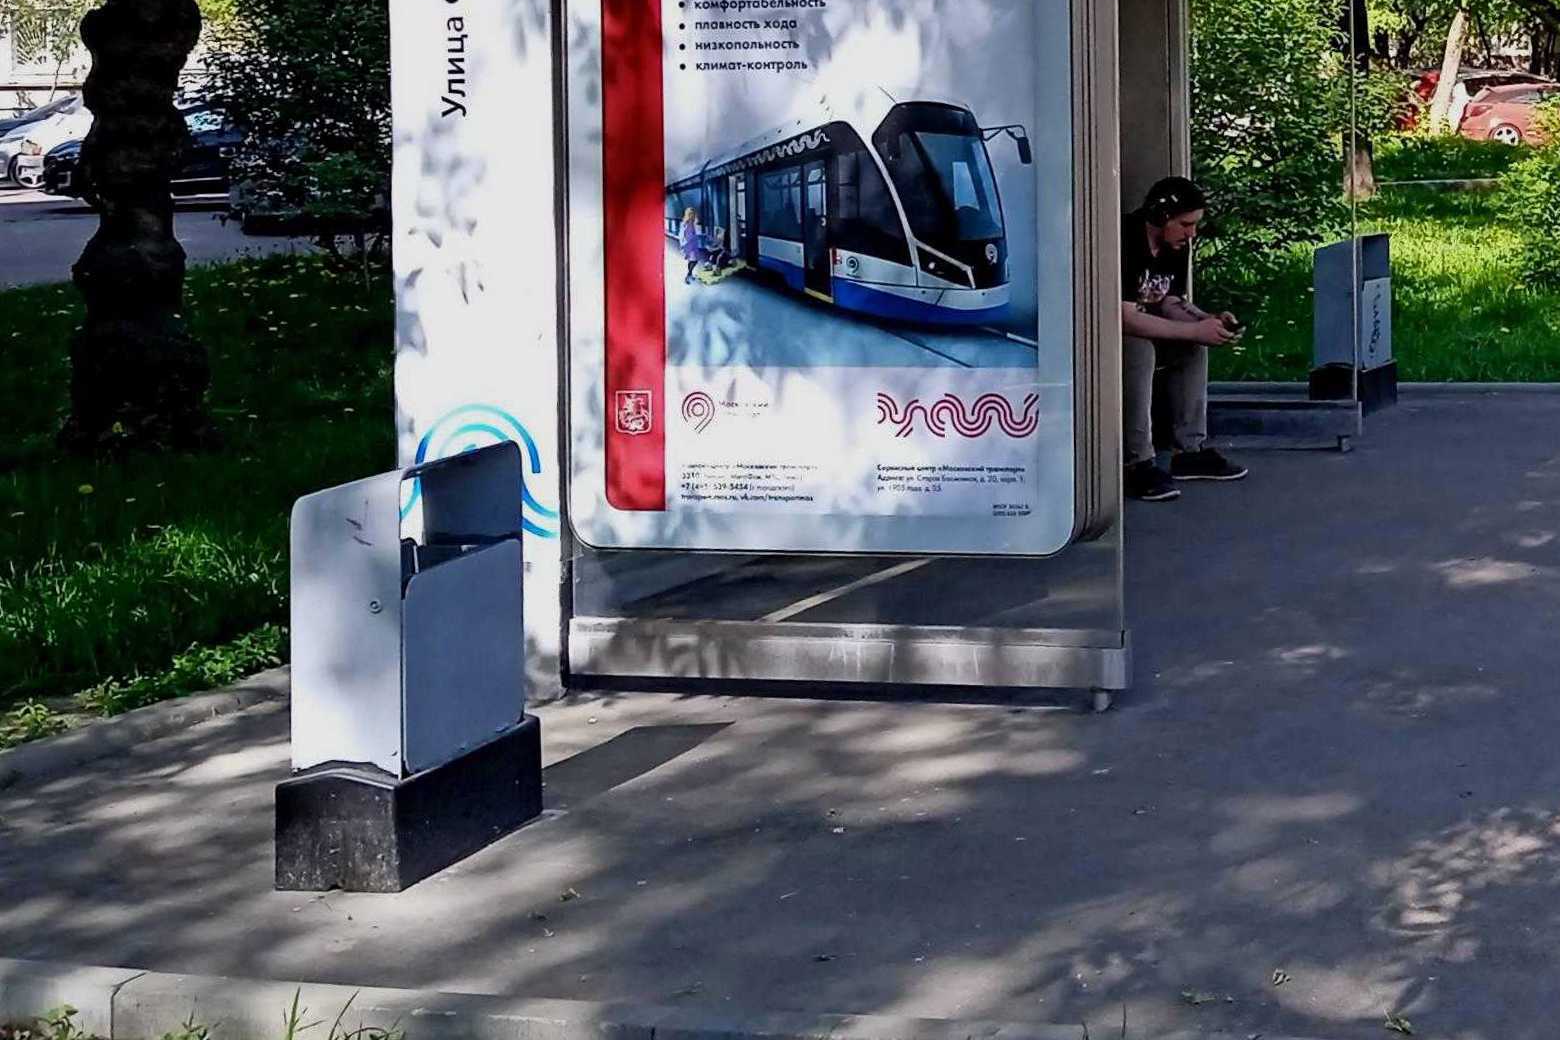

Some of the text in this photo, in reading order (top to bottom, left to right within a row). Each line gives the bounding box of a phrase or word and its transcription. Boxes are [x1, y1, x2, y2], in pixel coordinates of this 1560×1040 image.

[695, 18, 797, 32] плавность хода
[695, 39, 800, 52] низкопольность
[441, 15, 467, 118] Улица
[695, 61, 808, 74] климат-контроль
